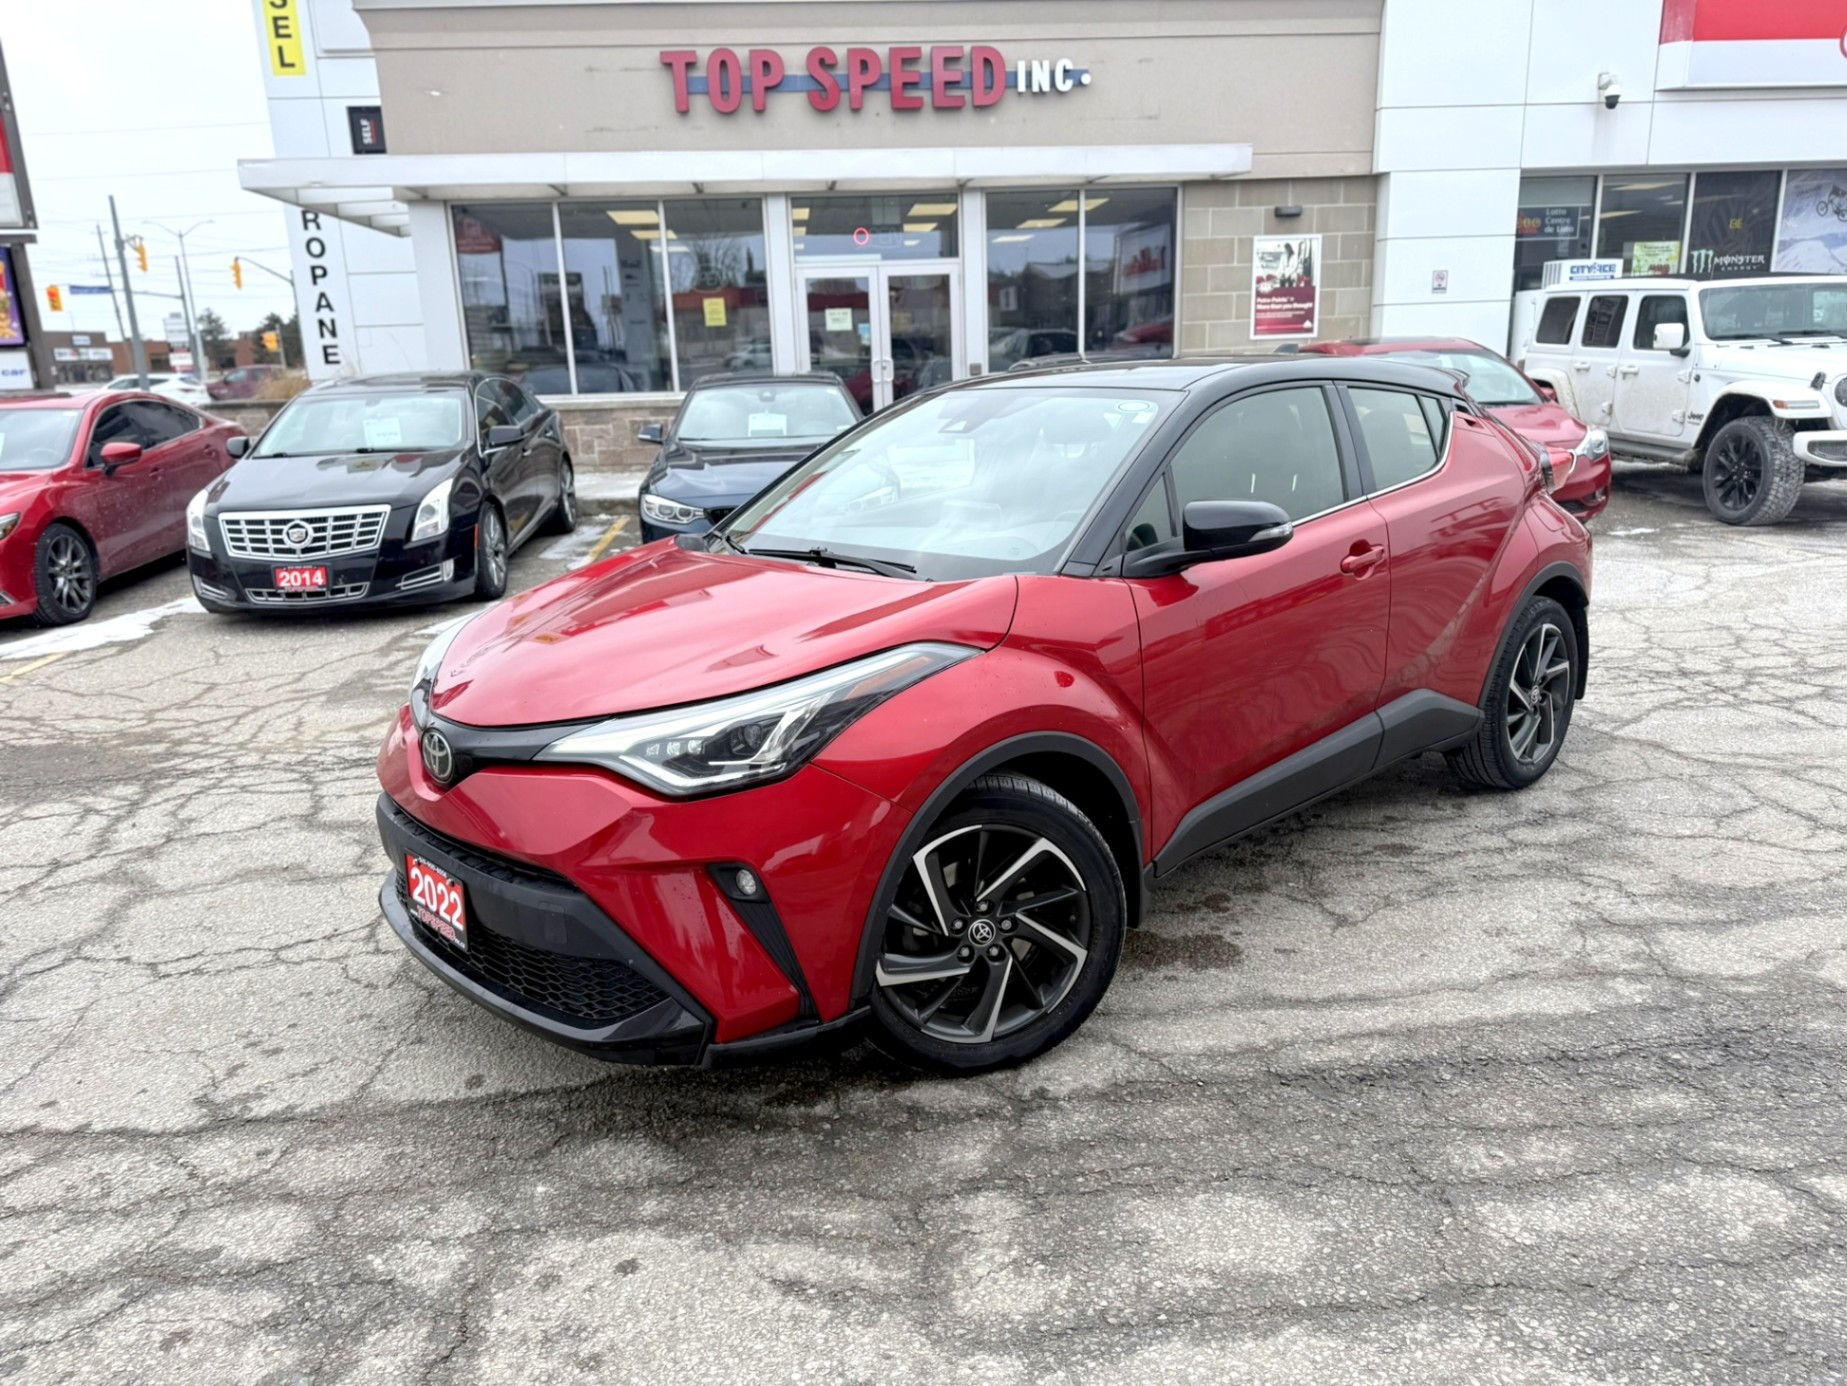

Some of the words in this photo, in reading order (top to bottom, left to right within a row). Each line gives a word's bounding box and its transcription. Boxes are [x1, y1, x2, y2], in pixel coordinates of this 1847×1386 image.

[660, 46, 785, 114] TOP
[805, 45, 1007, 112] SPEED
[1016, 58, 1093, 94] INC.
[1545, 208, 1567, 216] Lotto
[1544, 225, 1555, 233] de
[1713, 254, 1766, 266] MONSTER
[1687, 411, 1704, 421] Jeep
[279, 570, 324, 587] 2014
[410, 866, 464, 932] 2022
